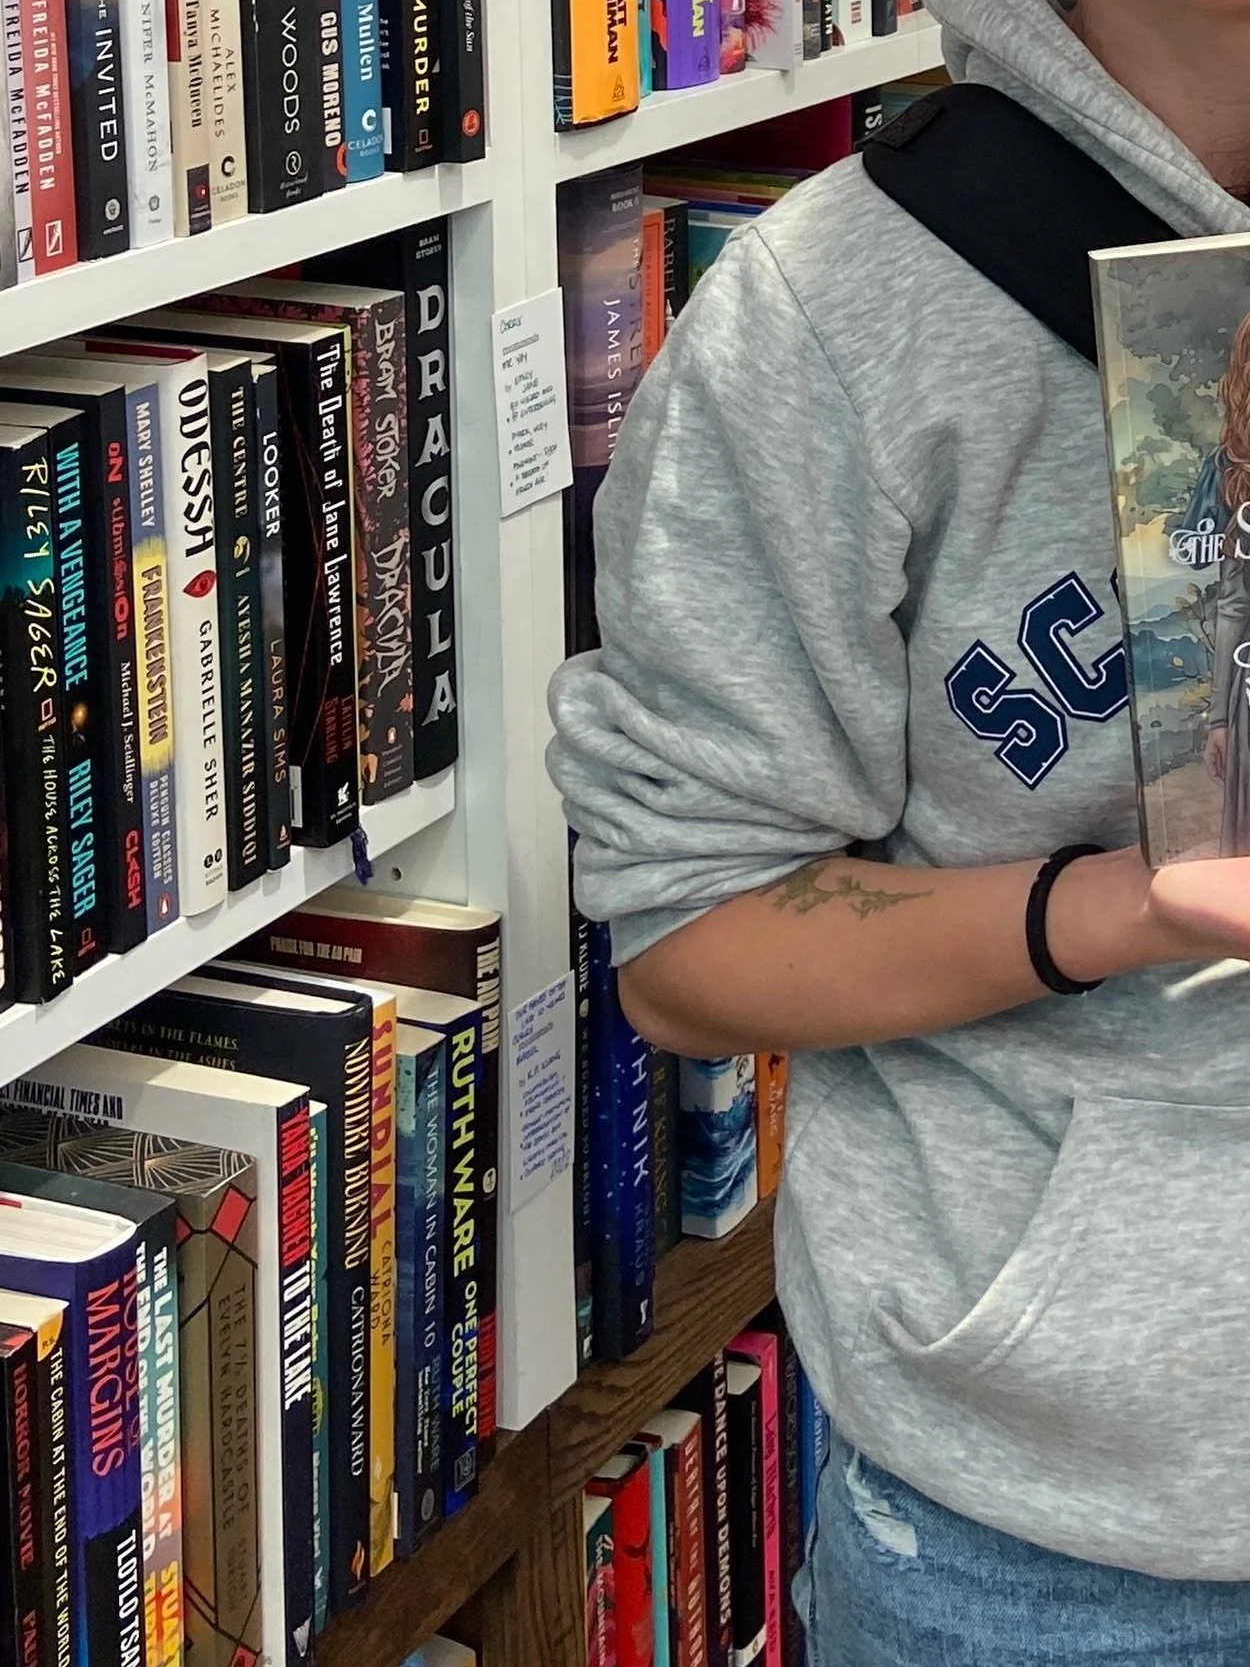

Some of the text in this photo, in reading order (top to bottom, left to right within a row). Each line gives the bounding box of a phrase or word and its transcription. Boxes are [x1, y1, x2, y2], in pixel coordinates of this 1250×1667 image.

[95, 28, 118, 160] INVITED
[281, 6, 300, 133] WOODS
[357, 3, 374, 81] Mullen
[604, 299, 621, 379] JAMES
[178, 379, 216, 558] ODESSA
[262, 431, 281, 538] LOOKER
[316, 344, 344, 667] The Death of Jane Lawrence
[415, 286, 457, 729] DRACULA
[20, 455, 57, 693] RILEY SAGER
[56, 442, 88, 692] WITH A VENGEANCE
[142, 564, 168, 747] FRANKENSTEIN
[199, 620, 219, 822] GABRIELLE SHER
[451, 1027, 476, 1278] RUTH WARE
[87, 1280, 125, 1477] MARGINS
[451, 1322, 464, 1419] COUPLE
[465, 1283, 478, 1435] ONE PERFECT
